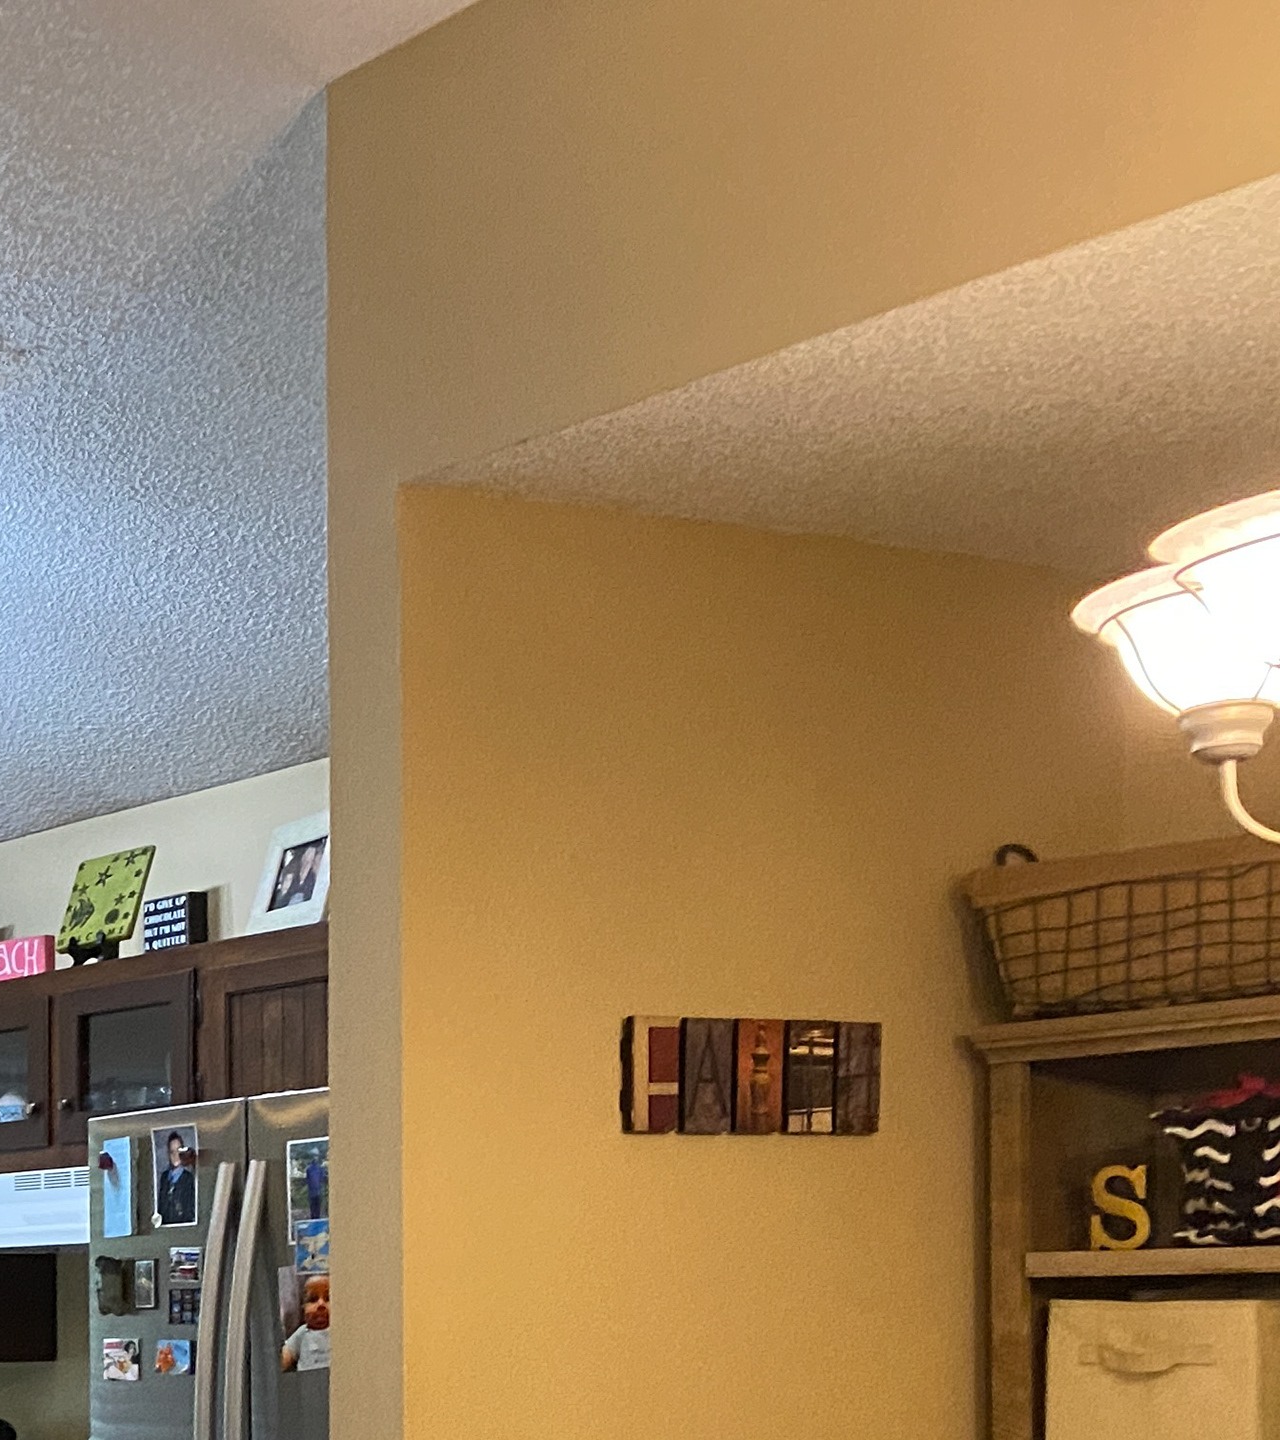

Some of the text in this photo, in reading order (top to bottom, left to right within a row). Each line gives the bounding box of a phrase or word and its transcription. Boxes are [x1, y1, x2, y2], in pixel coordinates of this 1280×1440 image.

[156, 898, 173, 910] GIVE
[175, 896, 186, 905] UP
[144, 908, 185, 925] CHOCOLATE
[144, 927, 158, 938] BUT
[171, 921, 185, 933] NOT
[152, 934, 186, 950] QUITTER
[1090, 1163, 1151, 1251] S
